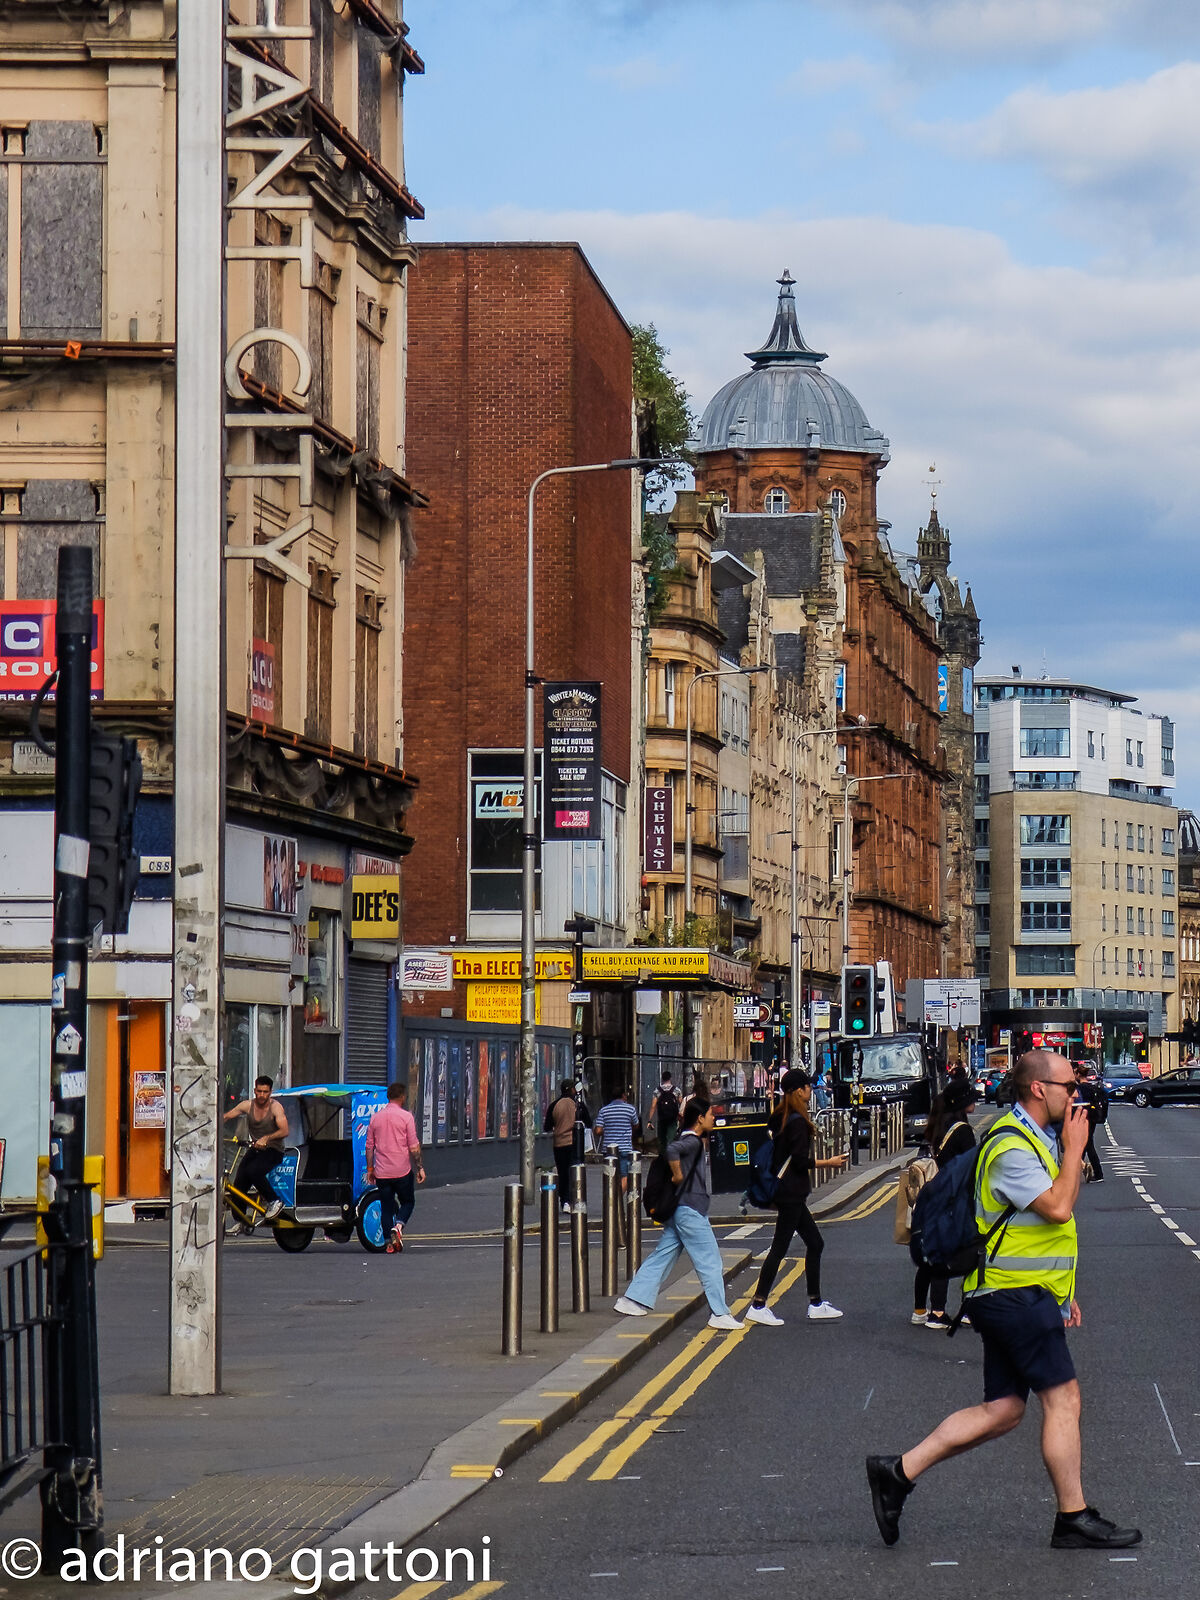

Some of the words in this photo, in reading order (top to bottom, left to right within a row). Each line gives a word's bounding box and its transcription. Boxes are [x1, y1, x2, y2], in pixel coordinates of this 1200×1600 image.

[225, 327, 314, 588] CITY
[252, 656, 273, 689] JCJ
[552, 708, 592, 718] GLASGOW
[653, 790, 666, 870] CHEMIST
[352, 889, 399, 922] DEE'S
[453, 959, 482, 975] Cha
[663, 957, 676, 965] AND
[680, 957, 705, 965] REPAIR
[500, 985, 519, 994] REPAIRS
[474, 997, 491, 1006] MOBILE
[492, 997, 507, 1006] PHONE
[468, 1010, 477, 1018] AND
[479, 1010, 487, 1018] ALL
